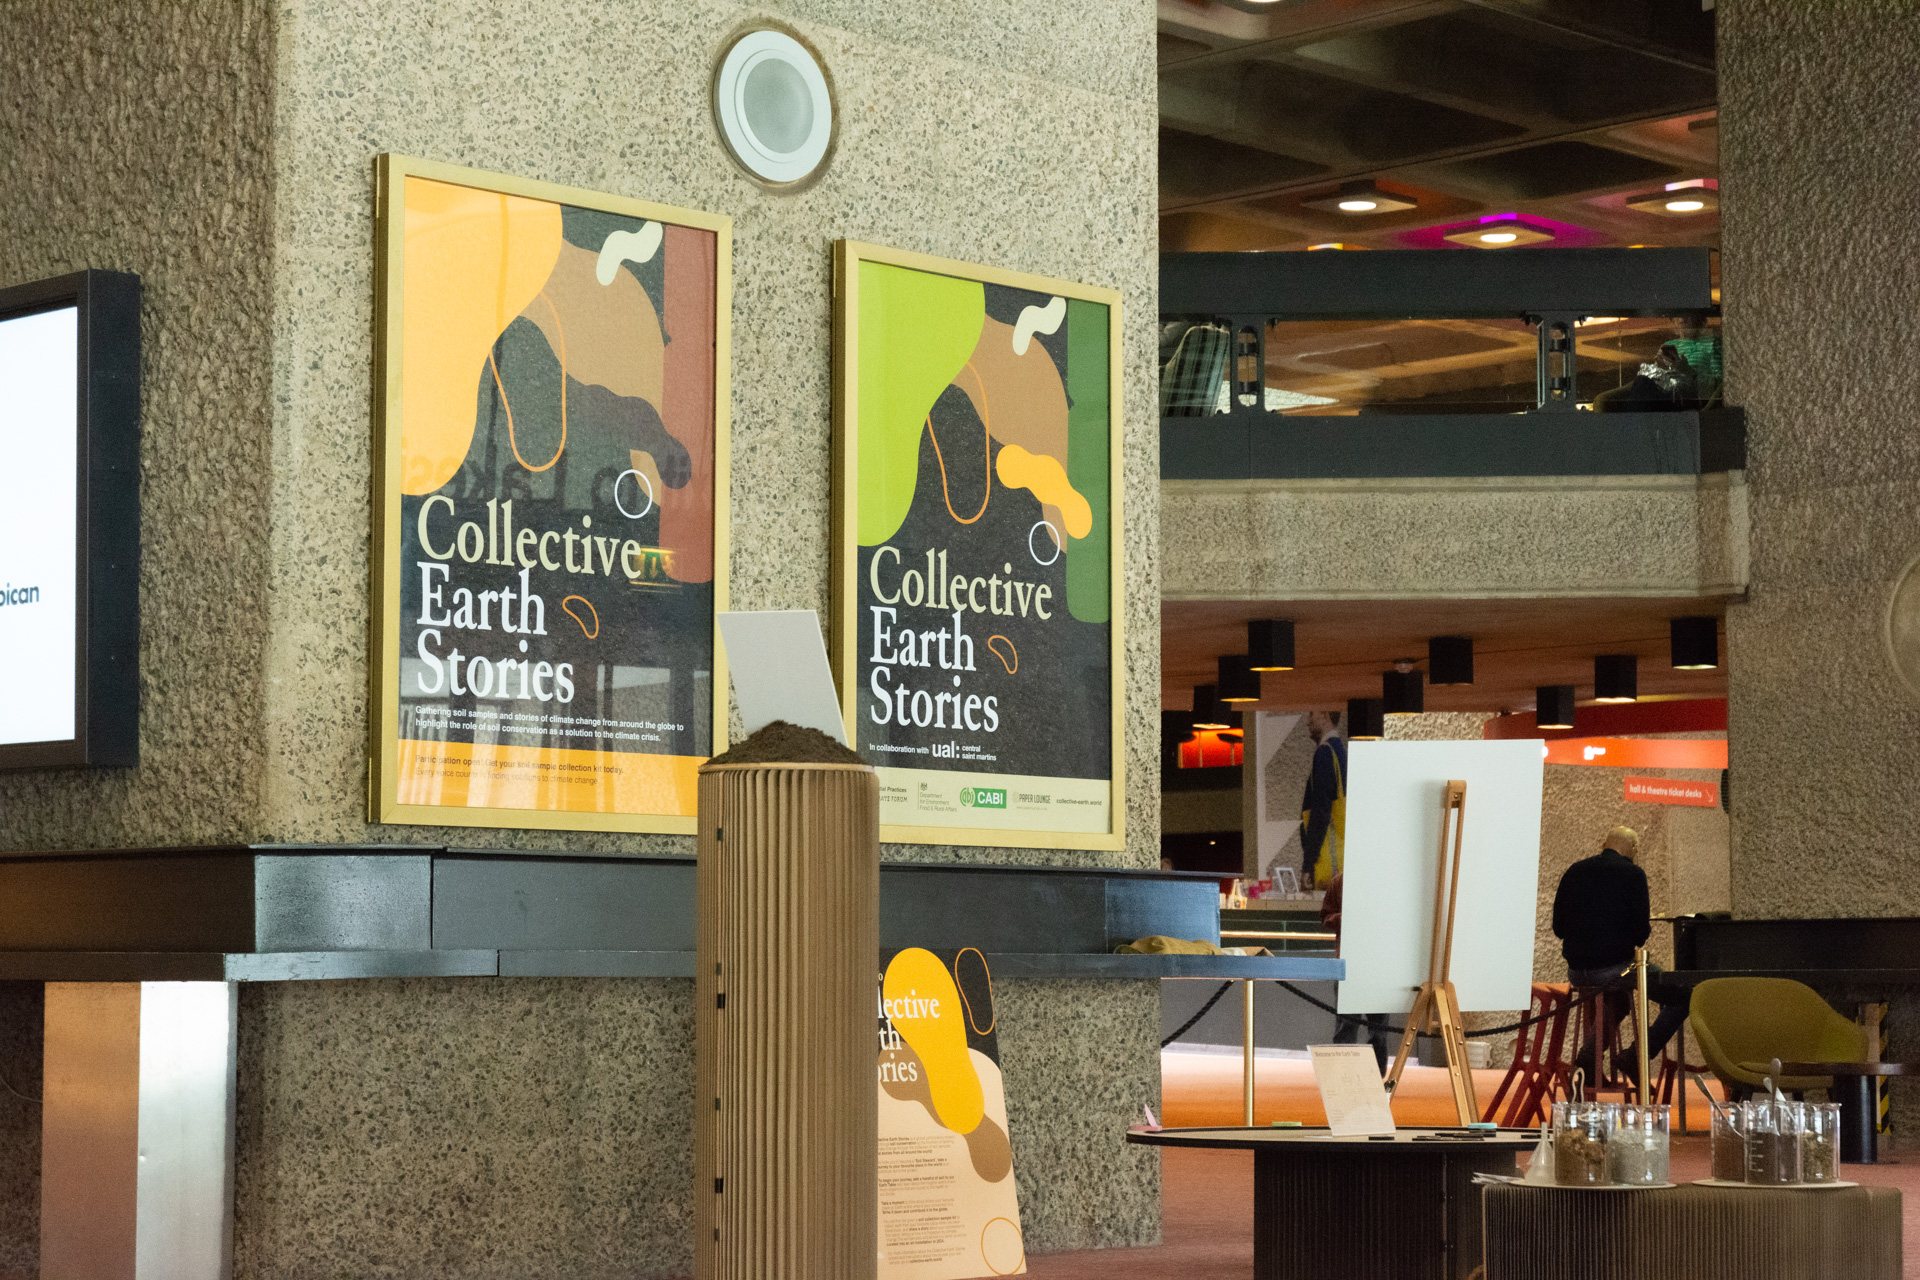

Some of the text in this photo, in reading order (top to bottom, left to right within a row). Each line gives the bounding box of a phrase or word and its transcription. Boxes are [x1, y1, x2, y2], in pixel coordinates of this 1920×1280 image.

[417, 494, 642, 579] Collective
[416, 561, 547, 635] Earth
[870, 545, 1052, 620] Collective
[417, 628, 575, 703] Stories
[869, 605, 977, 672] Earth
[415, 706, 684, 731] Gathering soil samples and stories of climate change from around the globe to
[415, 719, 448, 730] highlight
[449, 721, 460, 729] the
[462, 721, 477, 730] role
[478, 722, 487, 730] of
[487, 723, 500, 731] soil
[501, 724, 548, 735] conservation
[564, 729, 593, 738] solution
[594, 730, 602, 738] to
[603, 731, 614, 739] the
[615, 732, 640, 740] climate
[641, 733, 661, 741] crisis.
[870, 665, 999, 733] Stories
[415, 755, 461, 767] Particpation
[558, 764, 592, 772] collection
[869, 743, 930, 754] In collaboration with
[977, 791, 1003, 805] CABI
